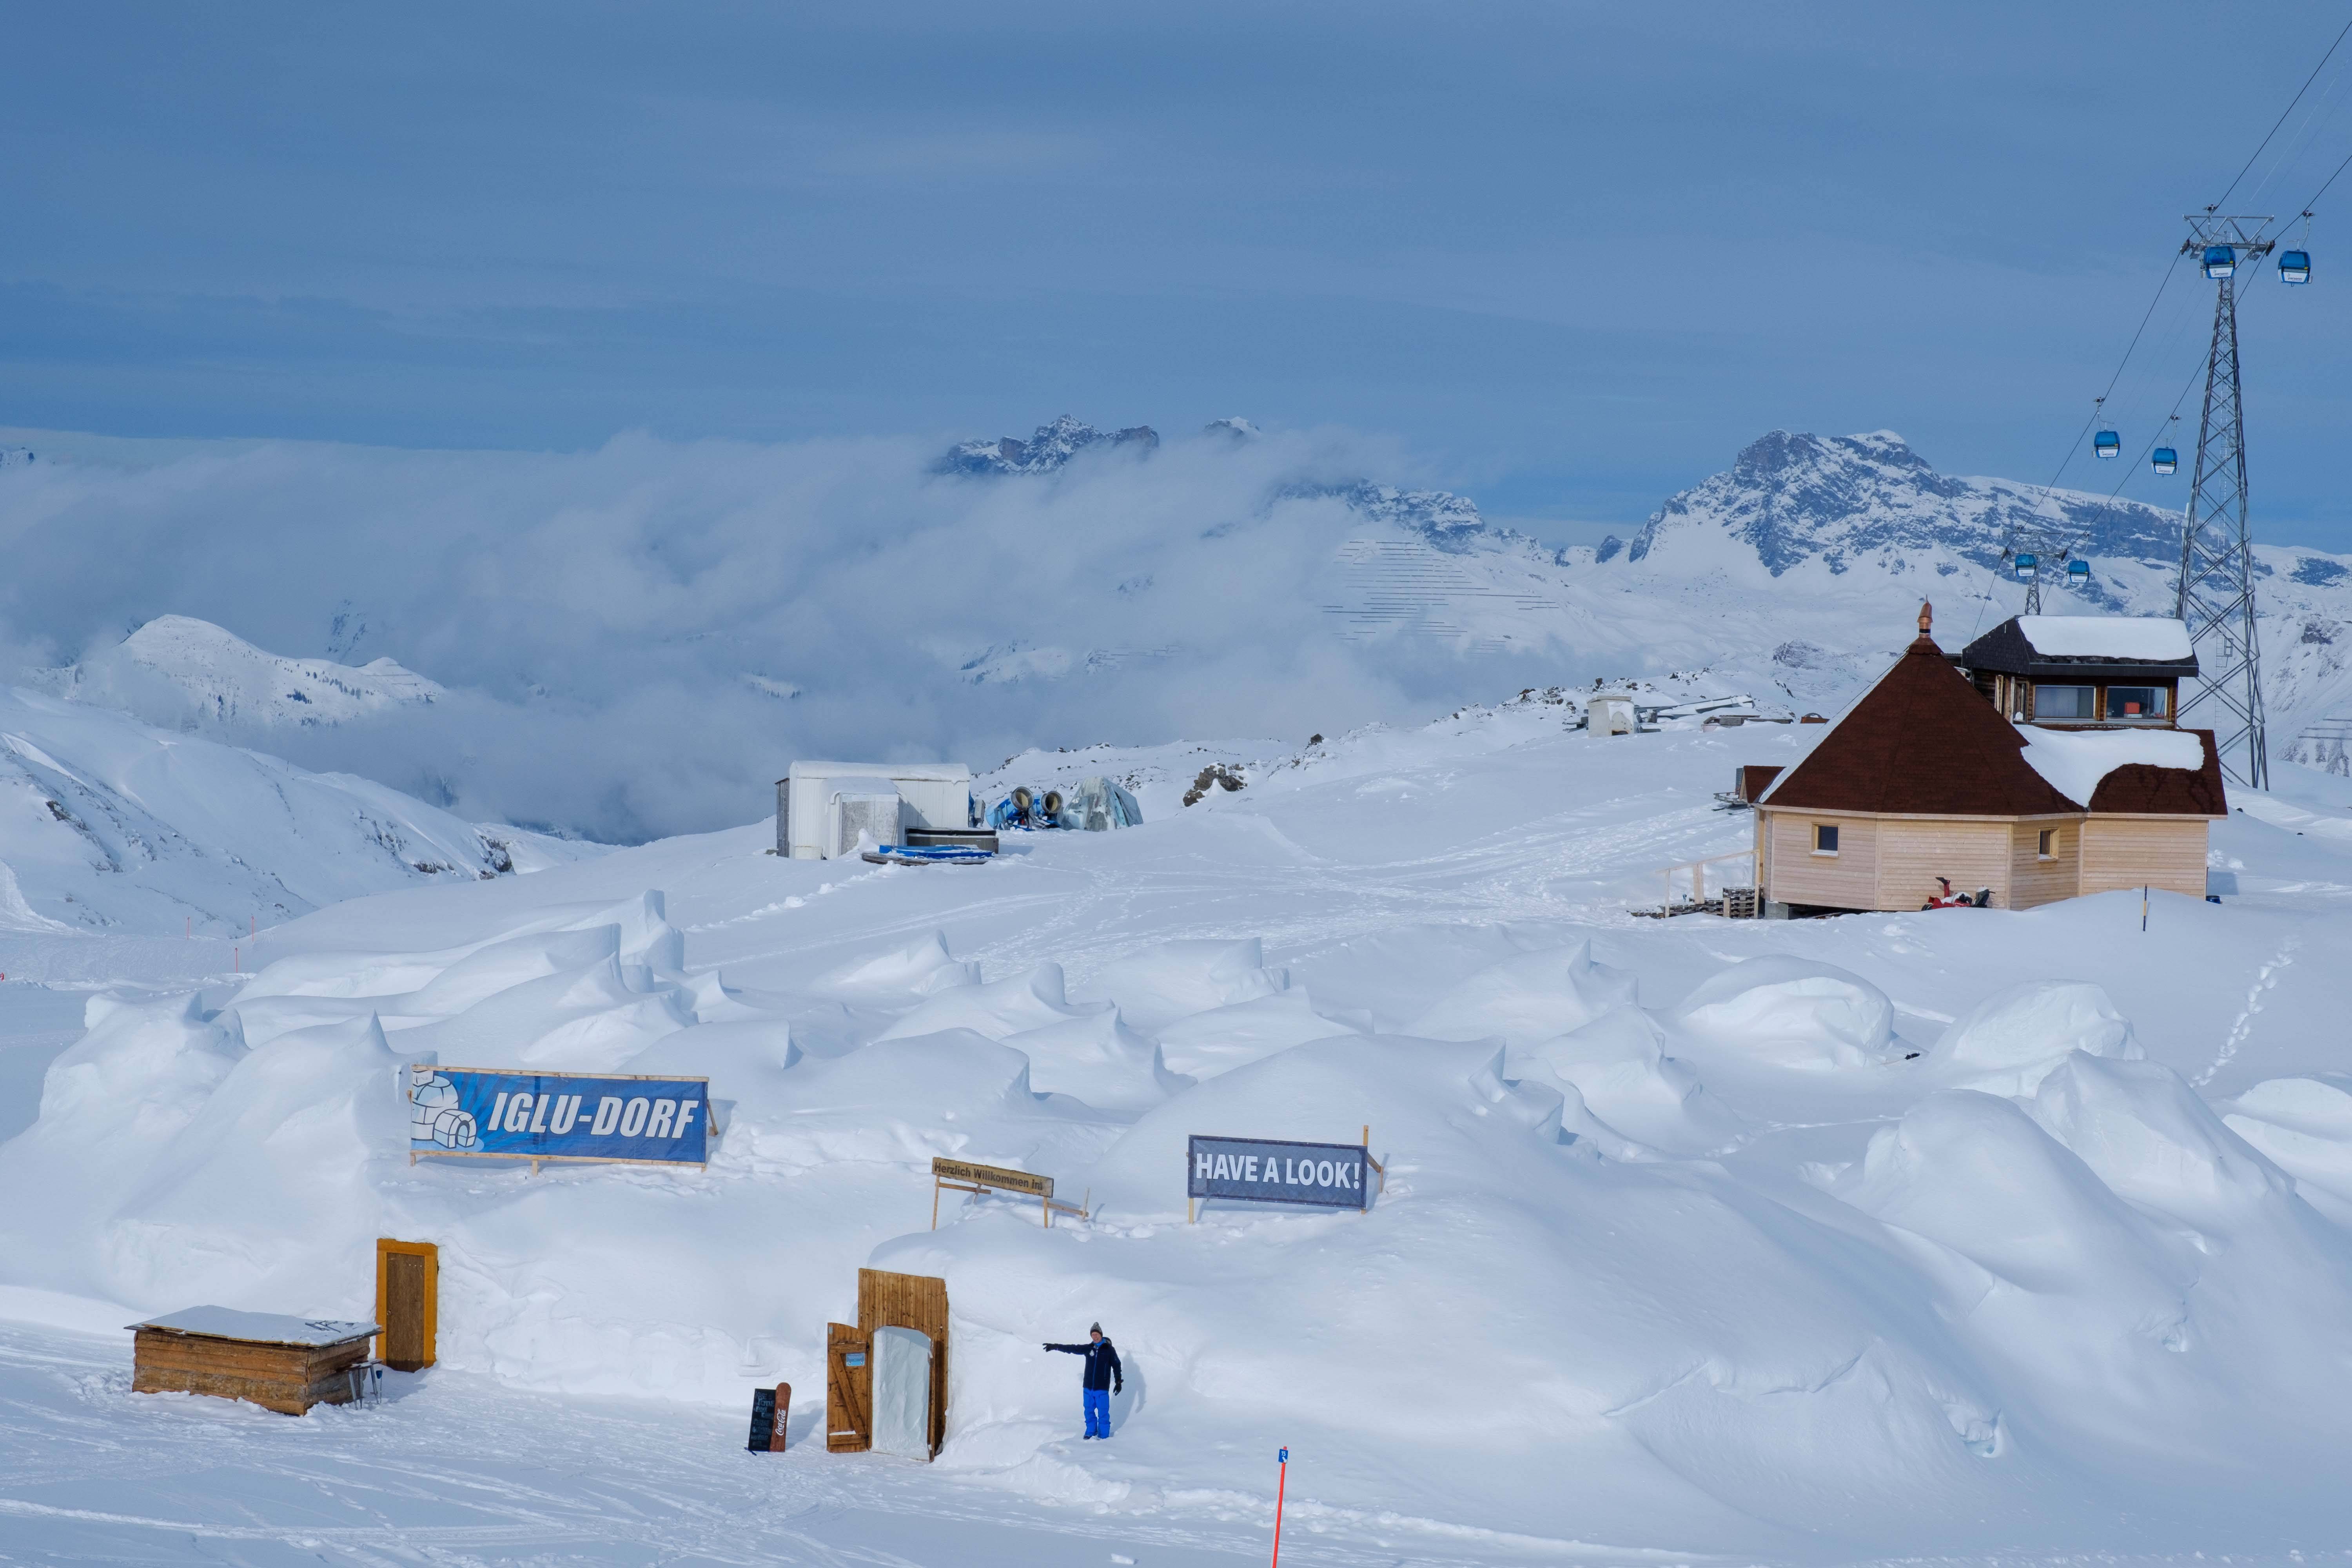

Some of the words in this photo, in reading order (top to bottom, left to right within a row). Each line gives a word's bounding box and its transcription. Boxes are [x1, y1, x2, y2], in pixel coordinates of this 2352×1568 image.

[487, 1092, 699, 1139] IGLU-DORF
[934, 1162, 971, 1178] Herzlich
[974, 1168, 1029, 1188] Willkommen
[1196, 1153, 1258, 1181] HAVE
[1263, 1157, 1279, 1183] A
[1286, 1158, 1360, 1190] LOOK!
